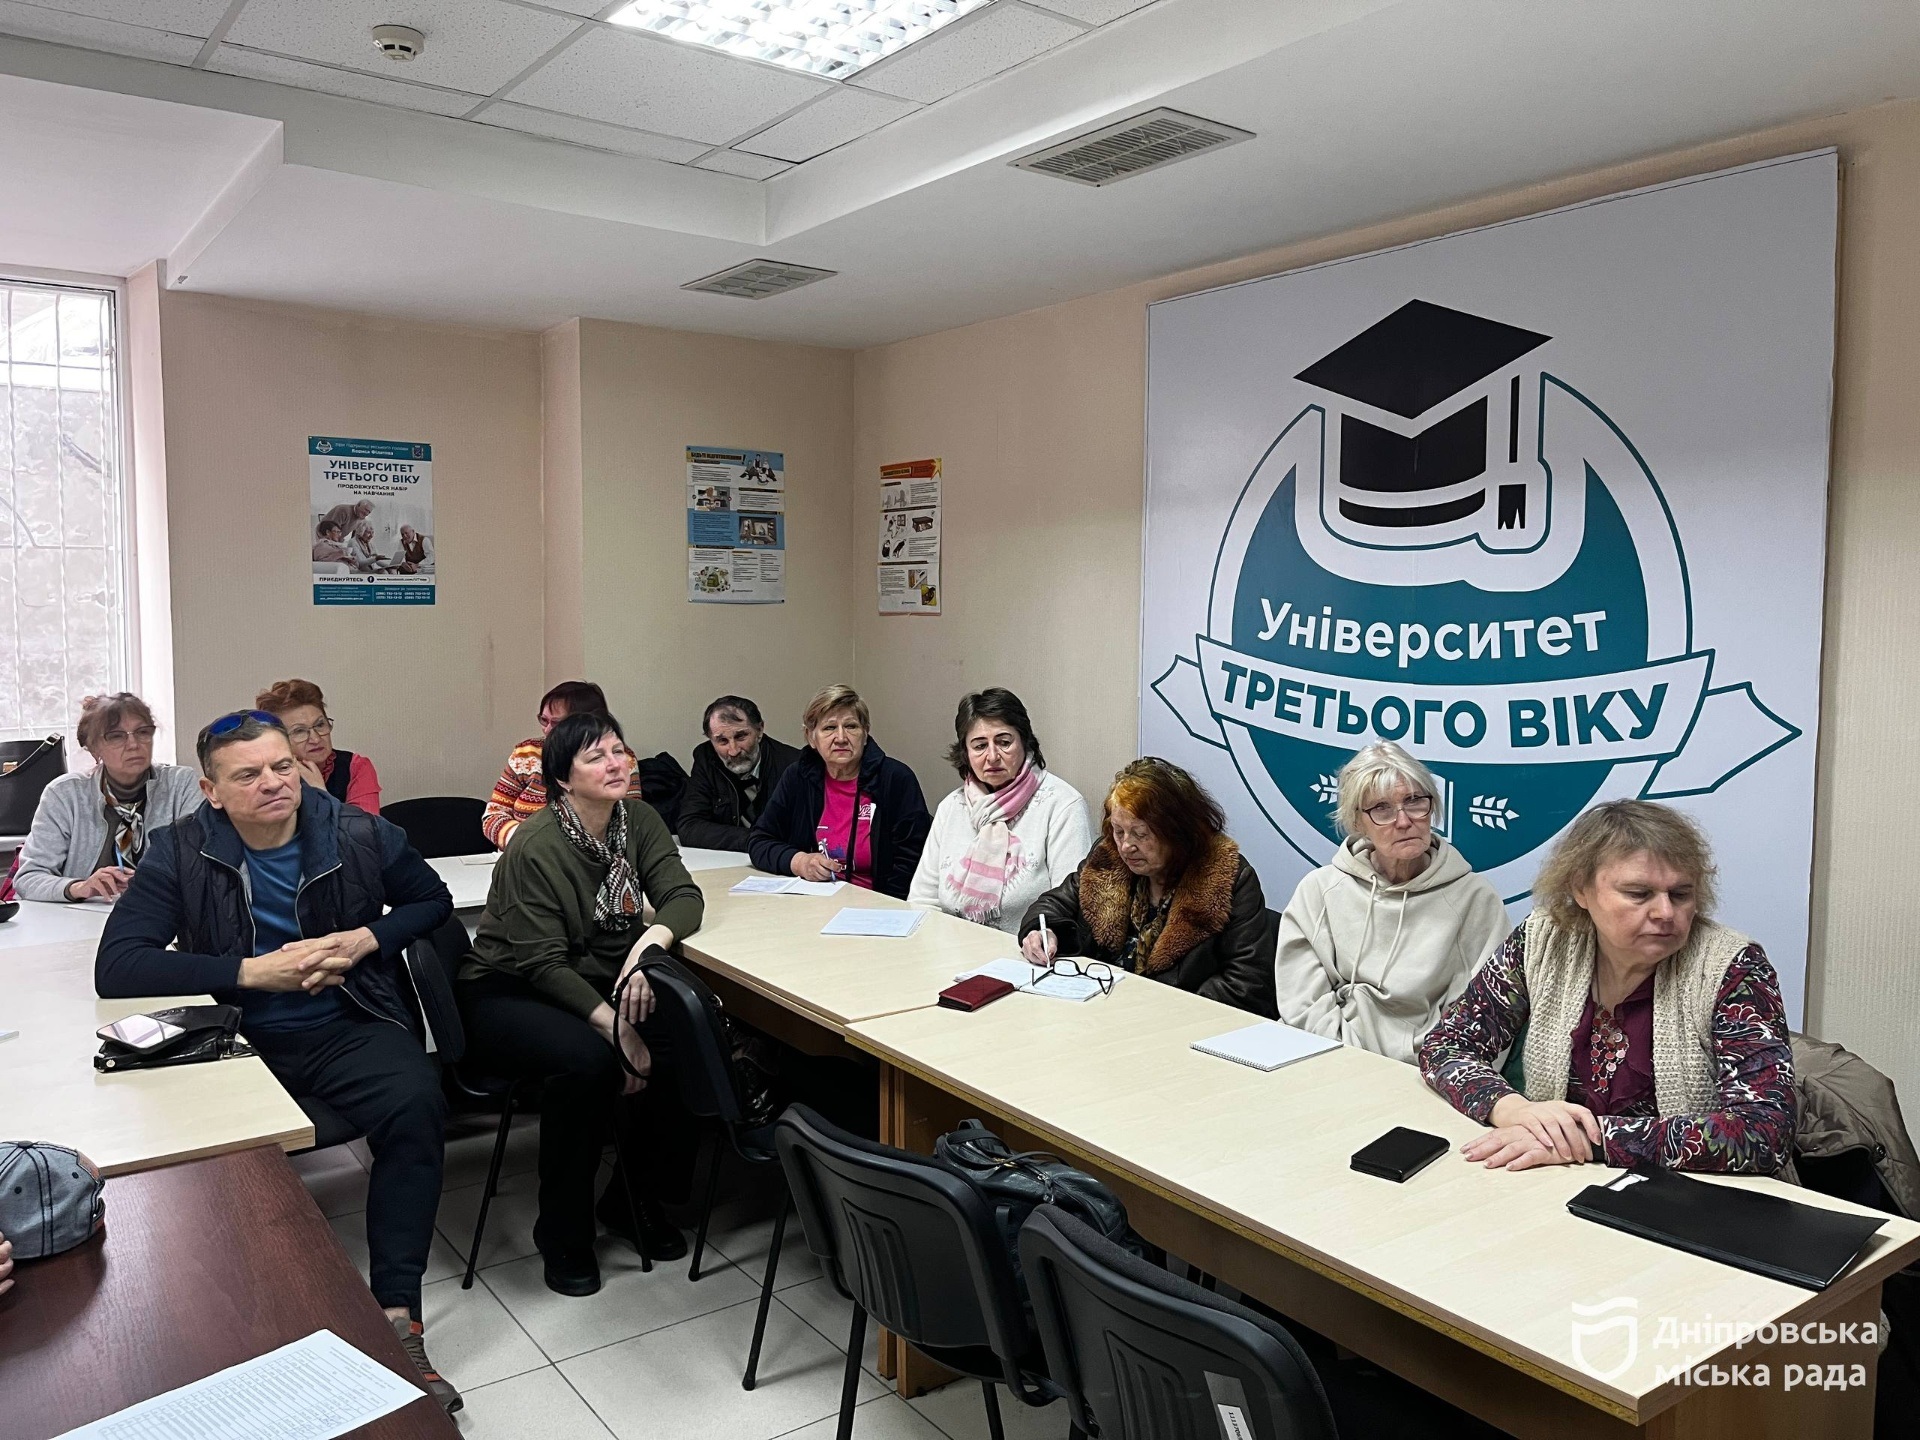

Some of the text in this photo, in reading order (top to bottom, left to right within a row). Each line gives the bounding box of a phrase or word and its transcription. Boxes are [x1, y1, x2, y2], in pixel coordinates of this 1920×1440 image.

[329, 459, 414, 473] УНІВЕРСИТЕТ
[323, 471, 420, 484] ТРЕТЬОГО ВІКУ
[337, 483, 390, 491] ПРОДОВЖУЄТЬСЯ
[1256, 597, 1607, 668] Університет
[1221, 661, 1670, 750] ТРЕТЬОГО ВІКУ
